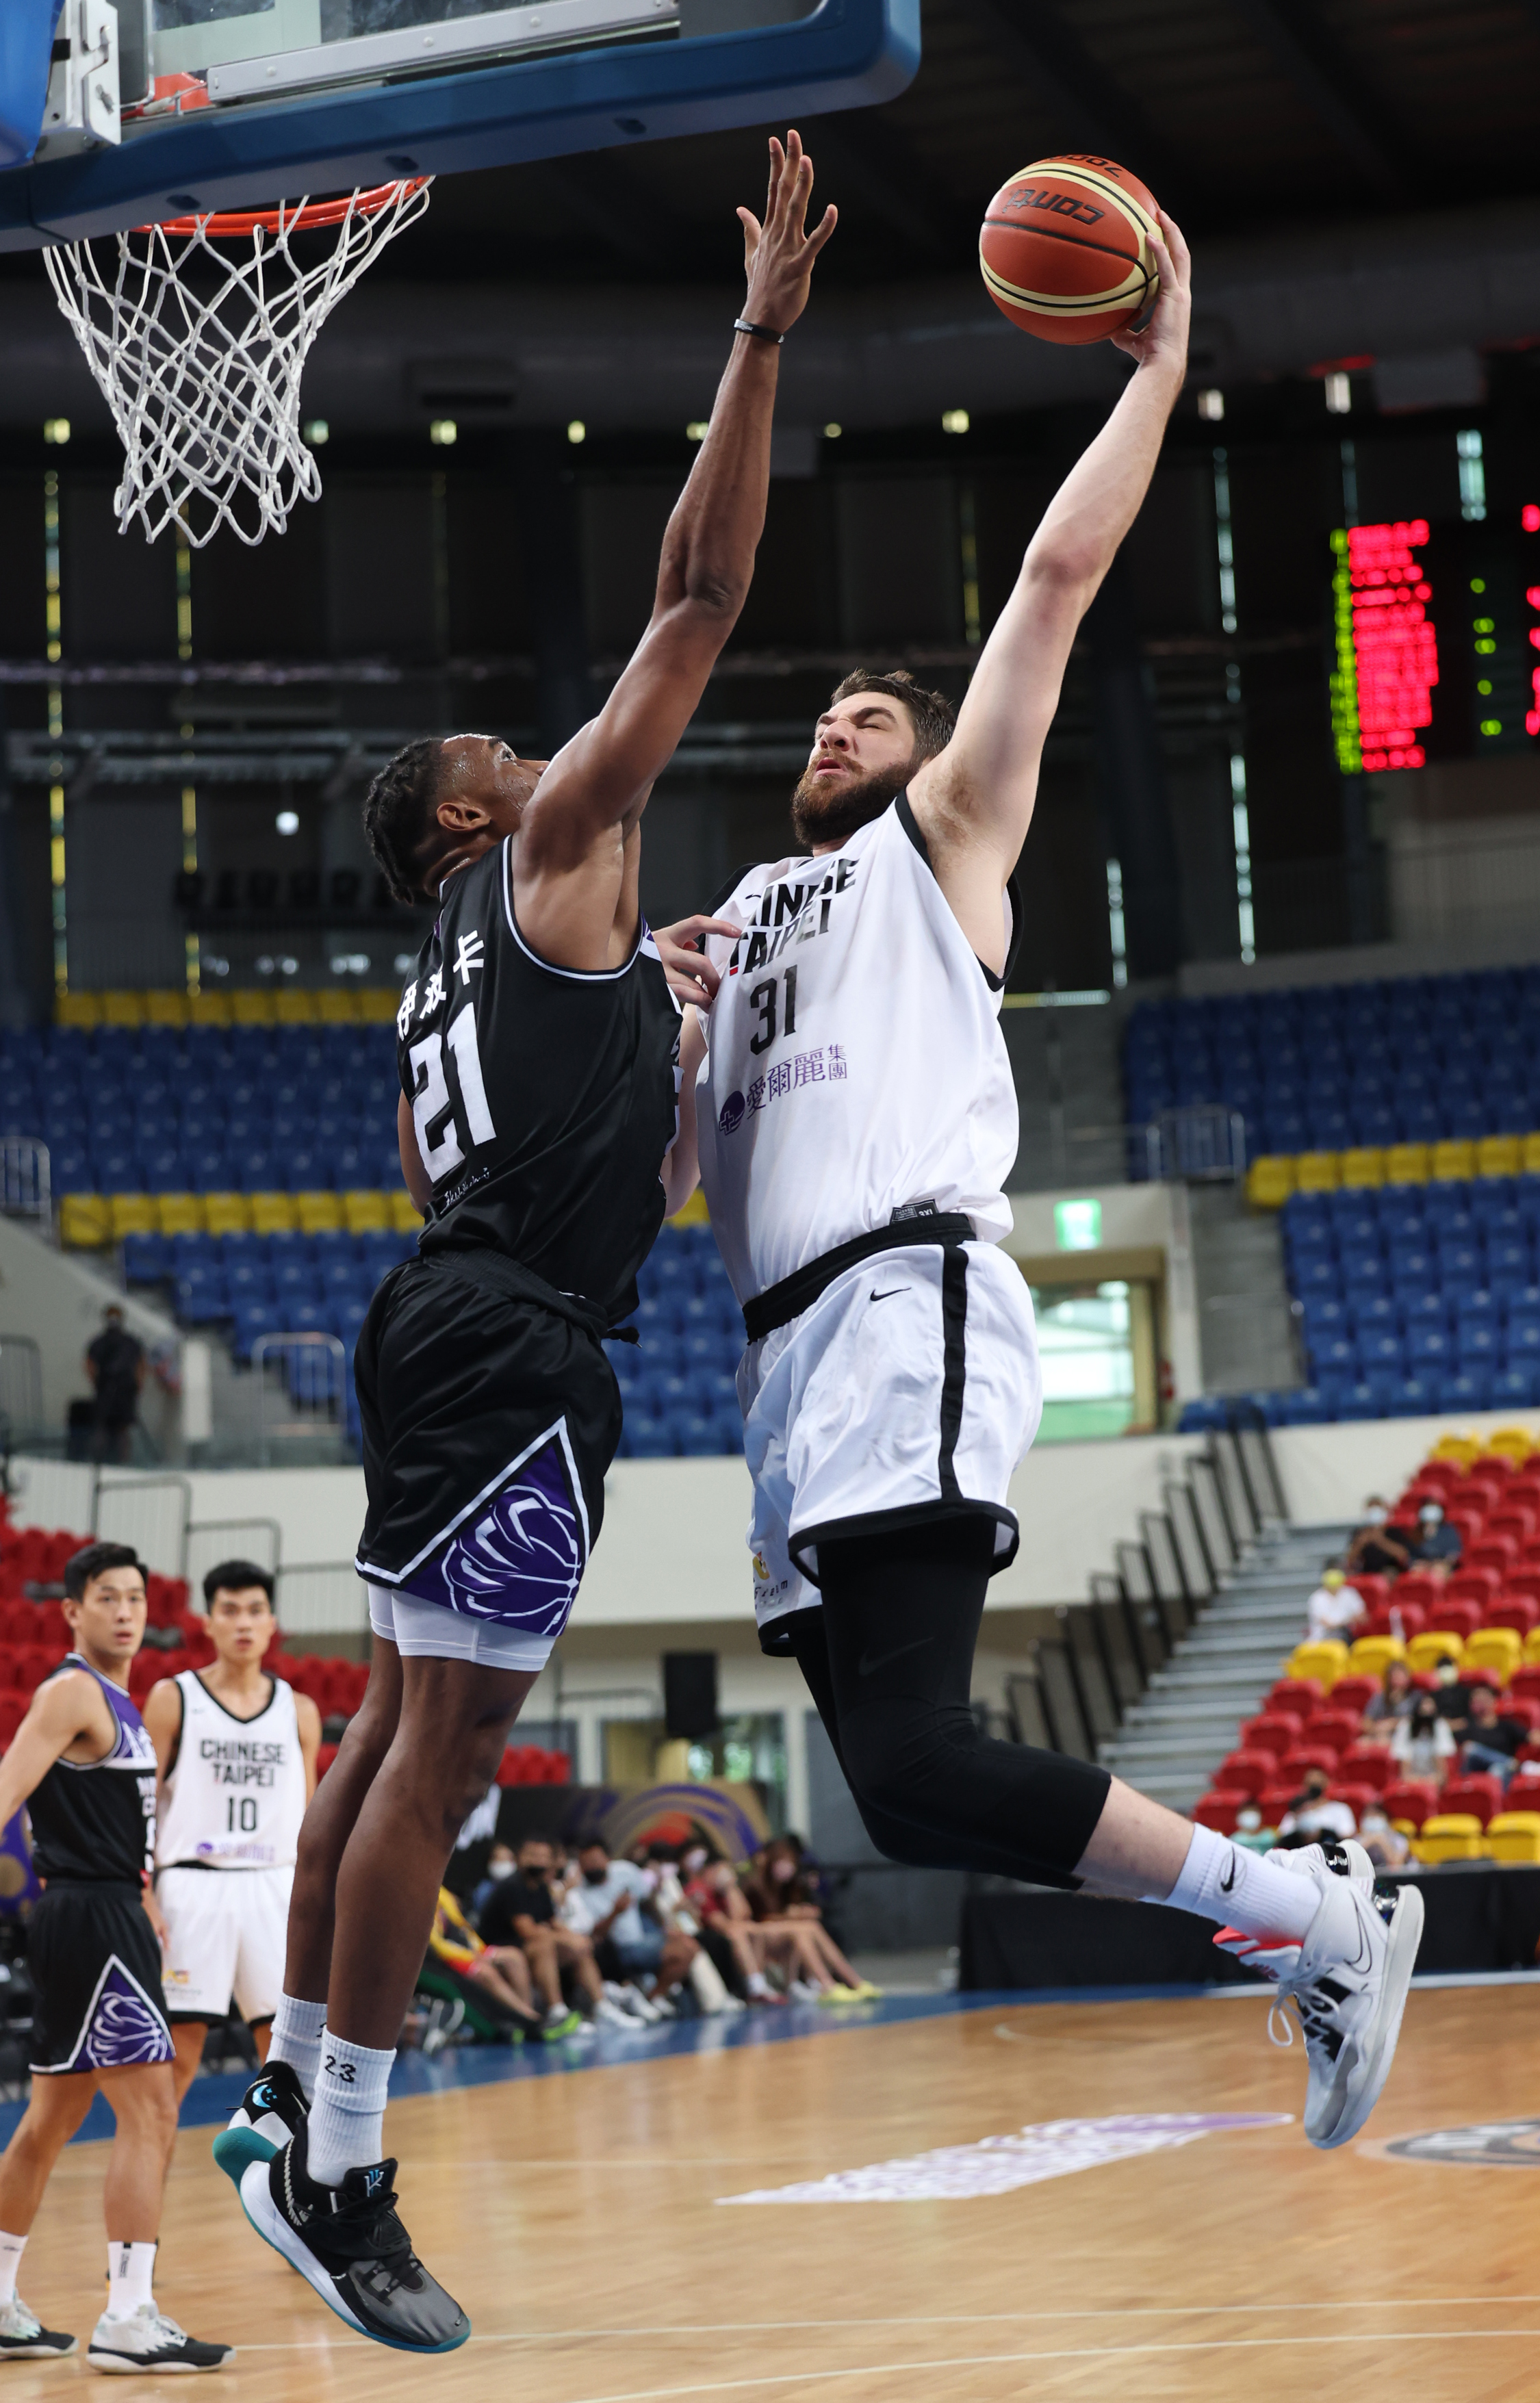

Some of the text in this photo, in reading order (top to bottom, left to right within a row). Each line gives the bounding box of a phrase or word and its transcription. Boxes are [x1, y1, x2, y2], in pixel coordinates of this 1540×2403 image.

[1001, 189, 1105, 226] conti
[729, 898, 832, 977] TAIPEI
[750, 964, 798, 1056] 31
[409, 1001, 498, 1183] 21
[201, 1739, 285, 1764] CHINESE
[213, 1763, 274, 1788] TAIPEI
[227, 1796, 257, 1833] 10
[324, 2055, 357, 2083] 23
